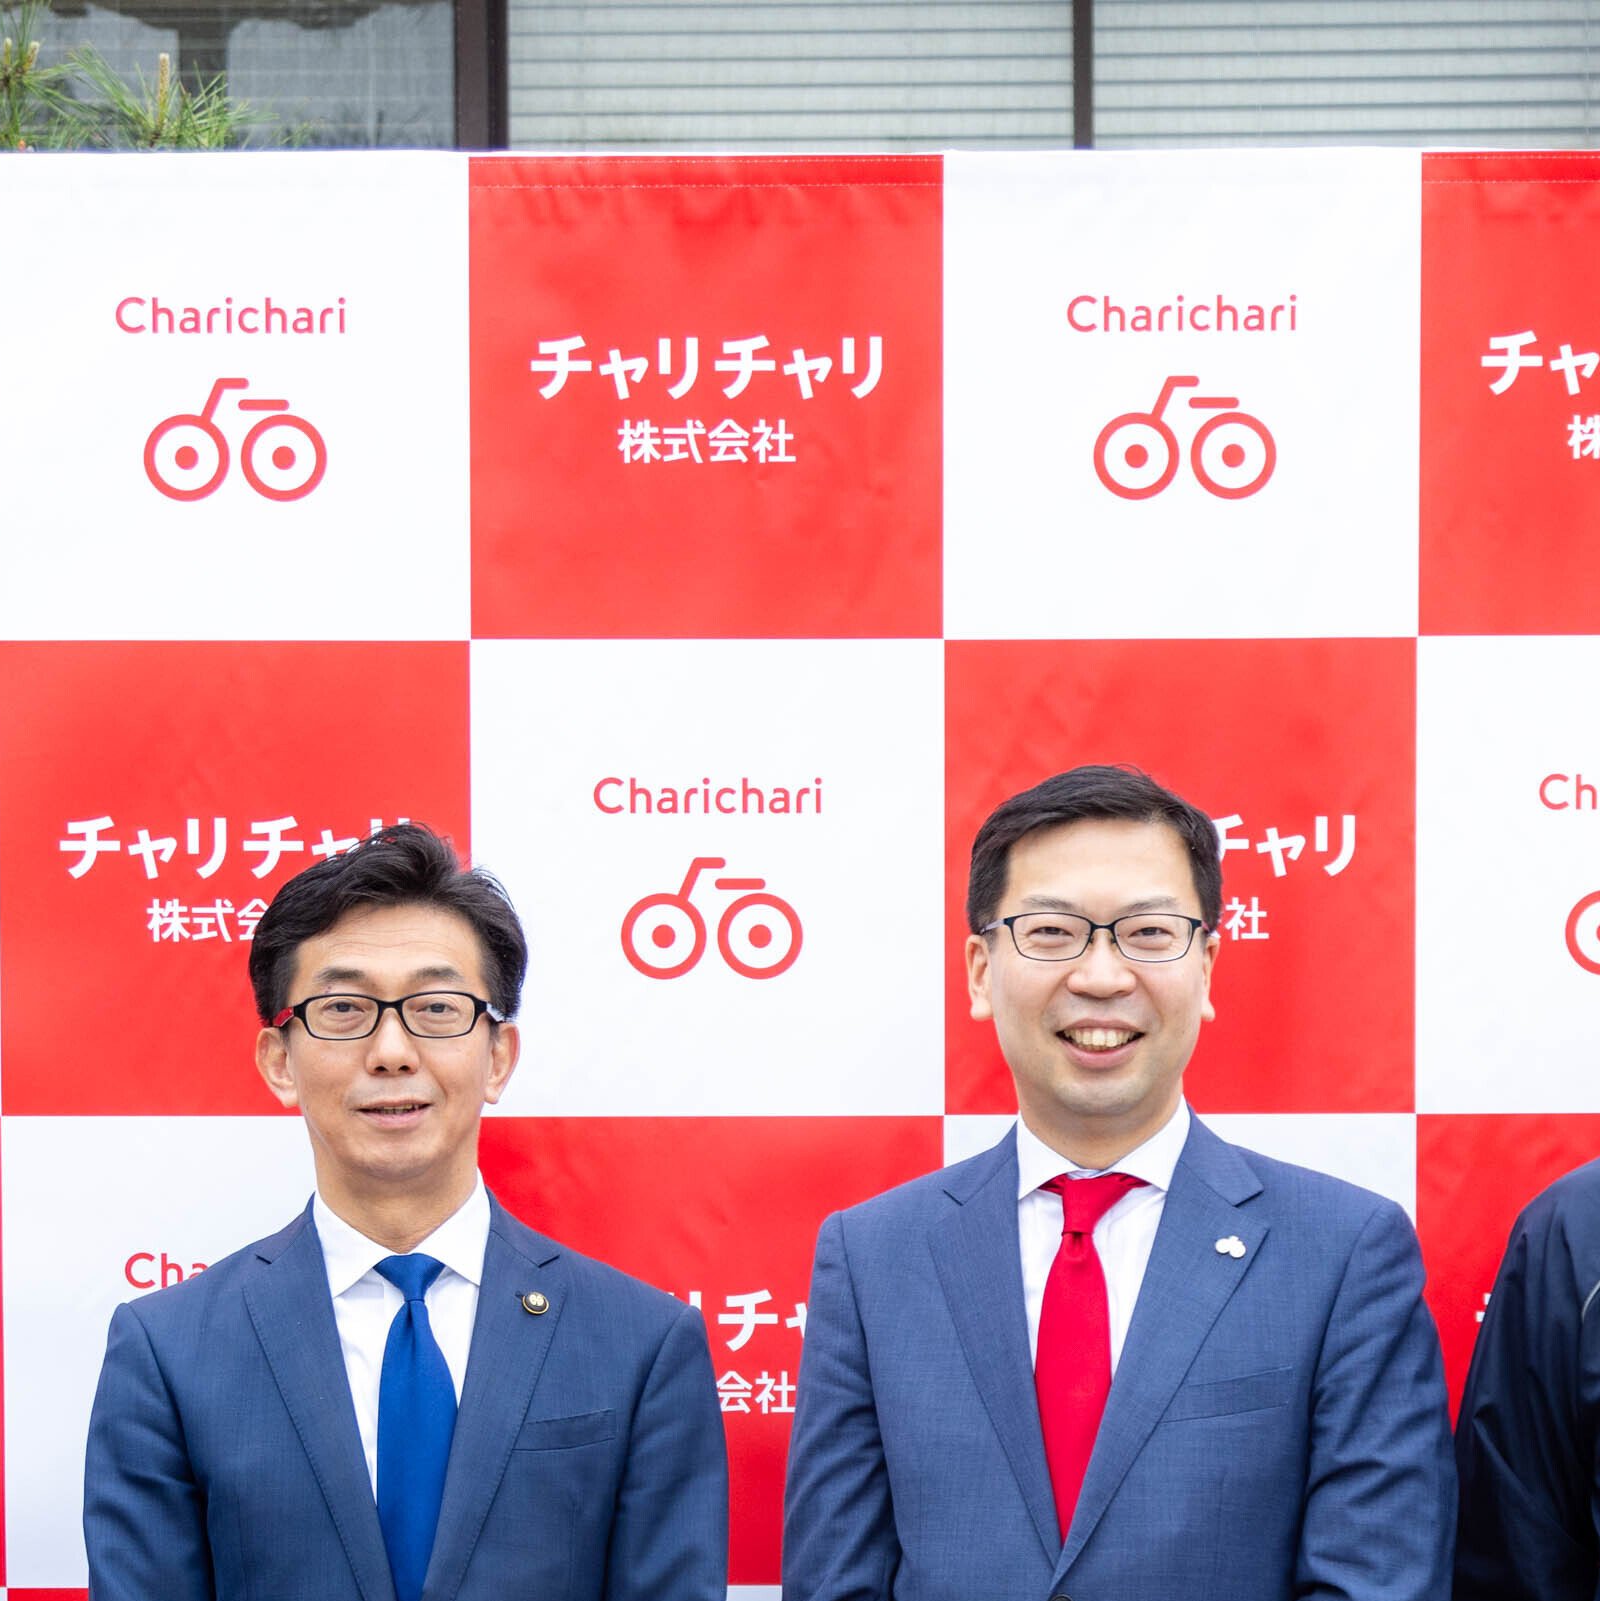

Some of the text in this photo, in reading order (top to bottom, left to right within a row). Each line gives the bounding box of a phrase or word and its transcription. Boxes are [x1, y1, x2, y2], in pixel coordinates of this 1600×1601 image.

[115, 296, 346, 335] Charichari
[1066, 294, 1297, 333] Charichari
[530, 335, 884, 400] チャリチャリ
[617, 418, 797, 464] 株式会社
[593, 776, 823, 815] Charichari
[146, 898, 269, 943] 株式会
[716, 1370, 797, 1414] 会社
